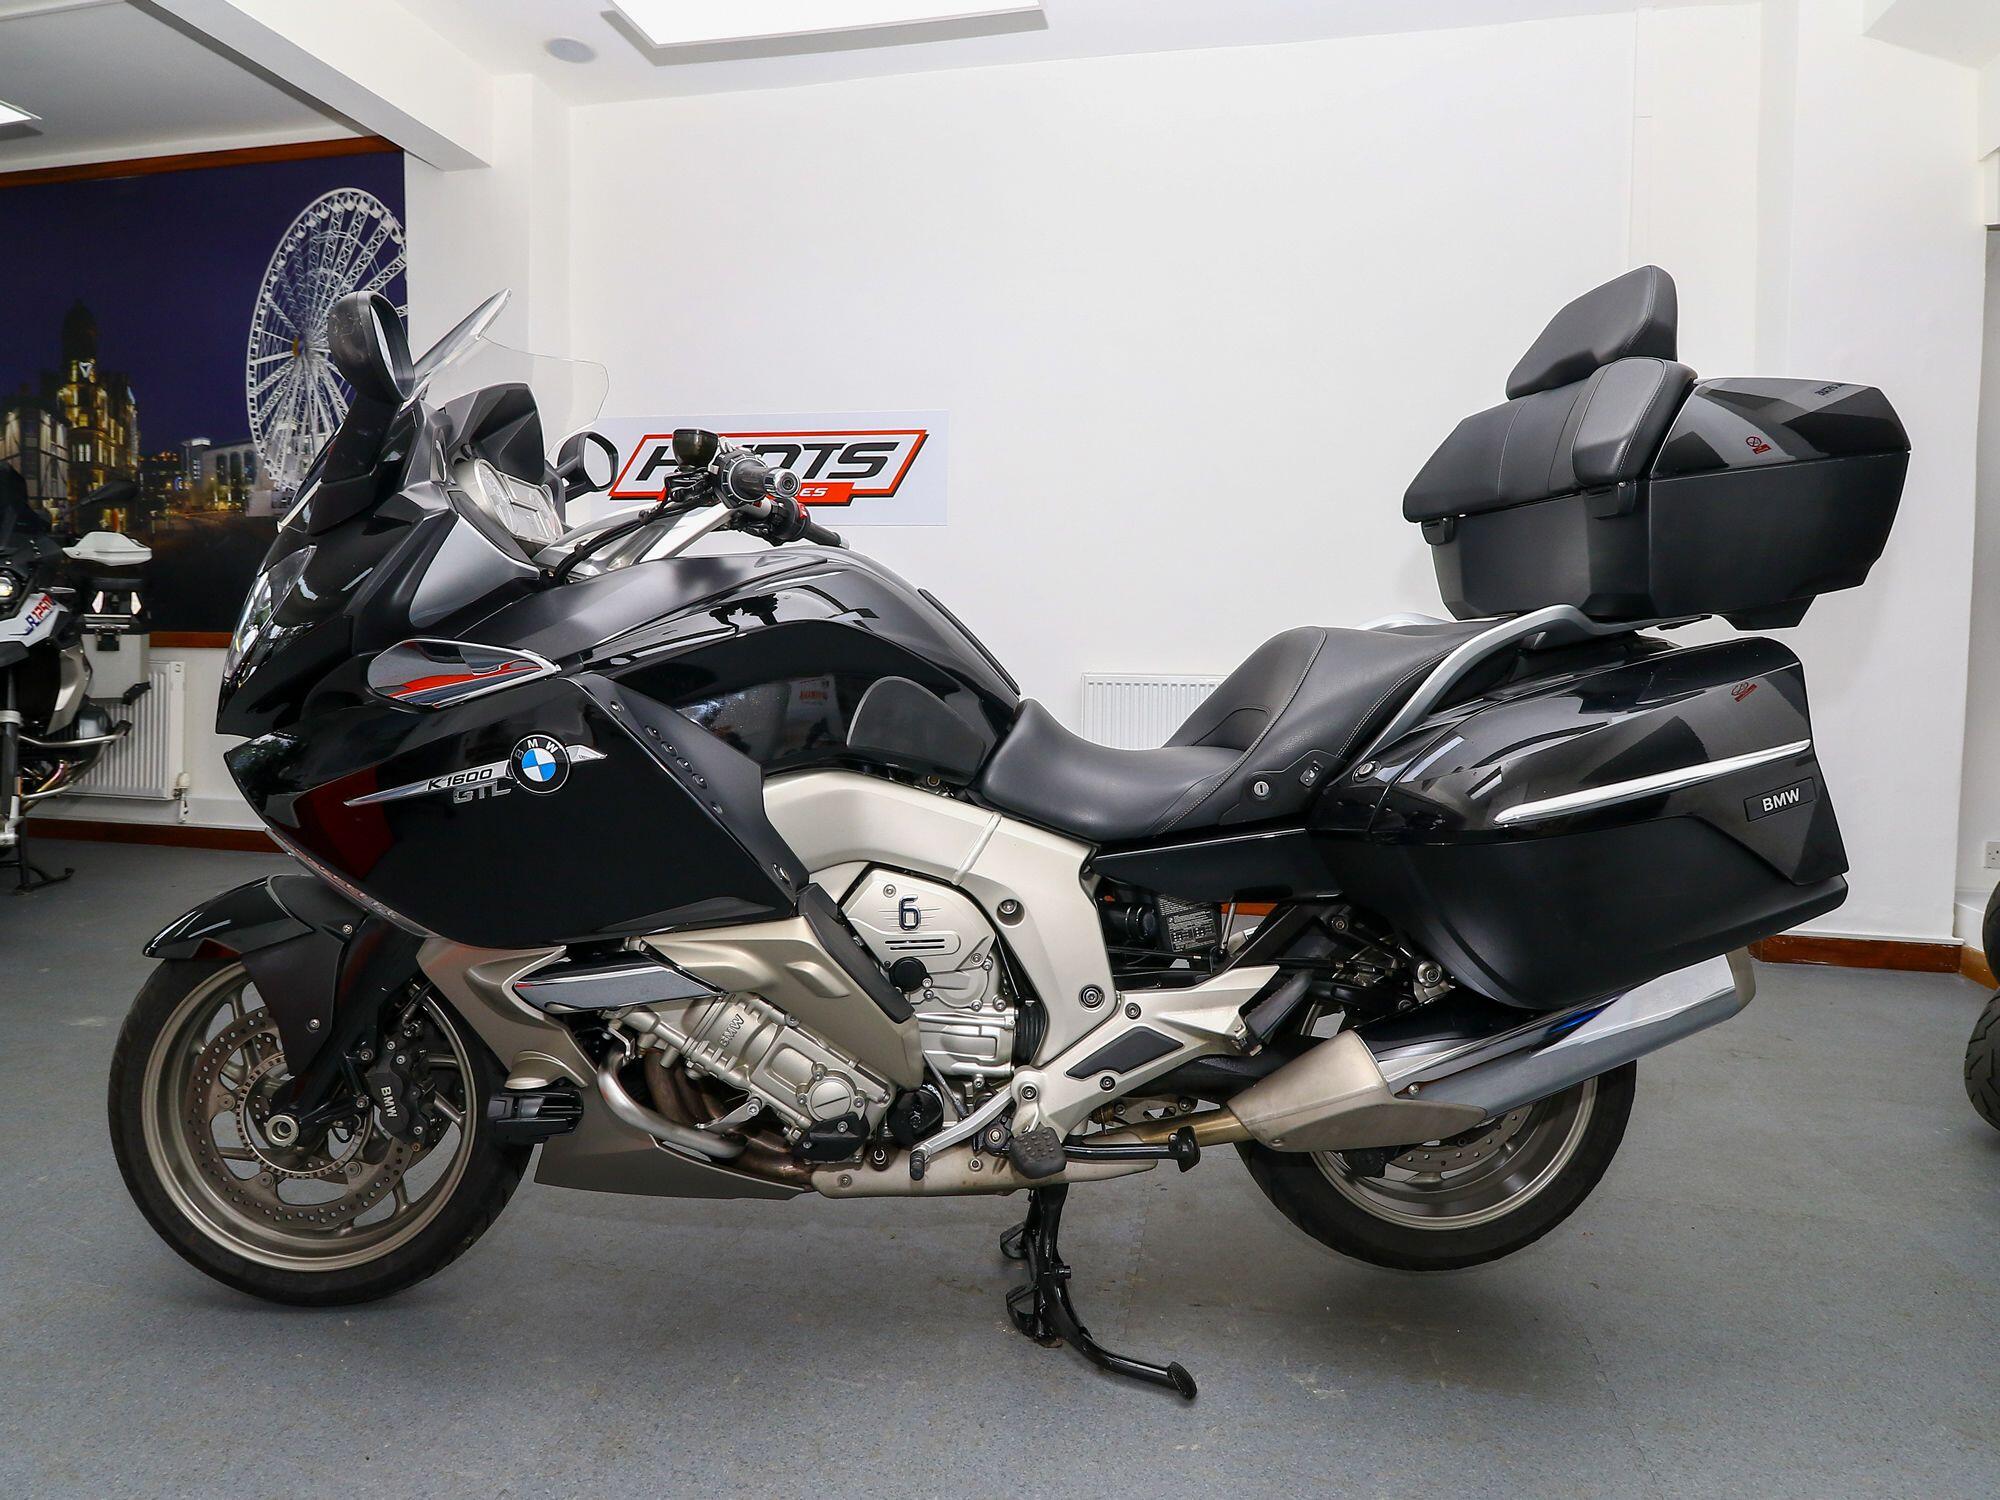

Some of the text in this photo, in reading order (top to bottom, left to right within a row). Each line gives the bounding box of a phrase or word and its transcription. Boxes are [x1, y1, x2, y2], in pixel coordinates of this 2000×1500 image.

[515, 738, 559, 760] BMW
[453, 780, 512, 804] GTL
[1762, 787, 1799, 812] BMW
[899, 894, 921, 931] 6
[720, 1013, 745, 1048] BMW
[380, 1086, 398, 1118] BMW
